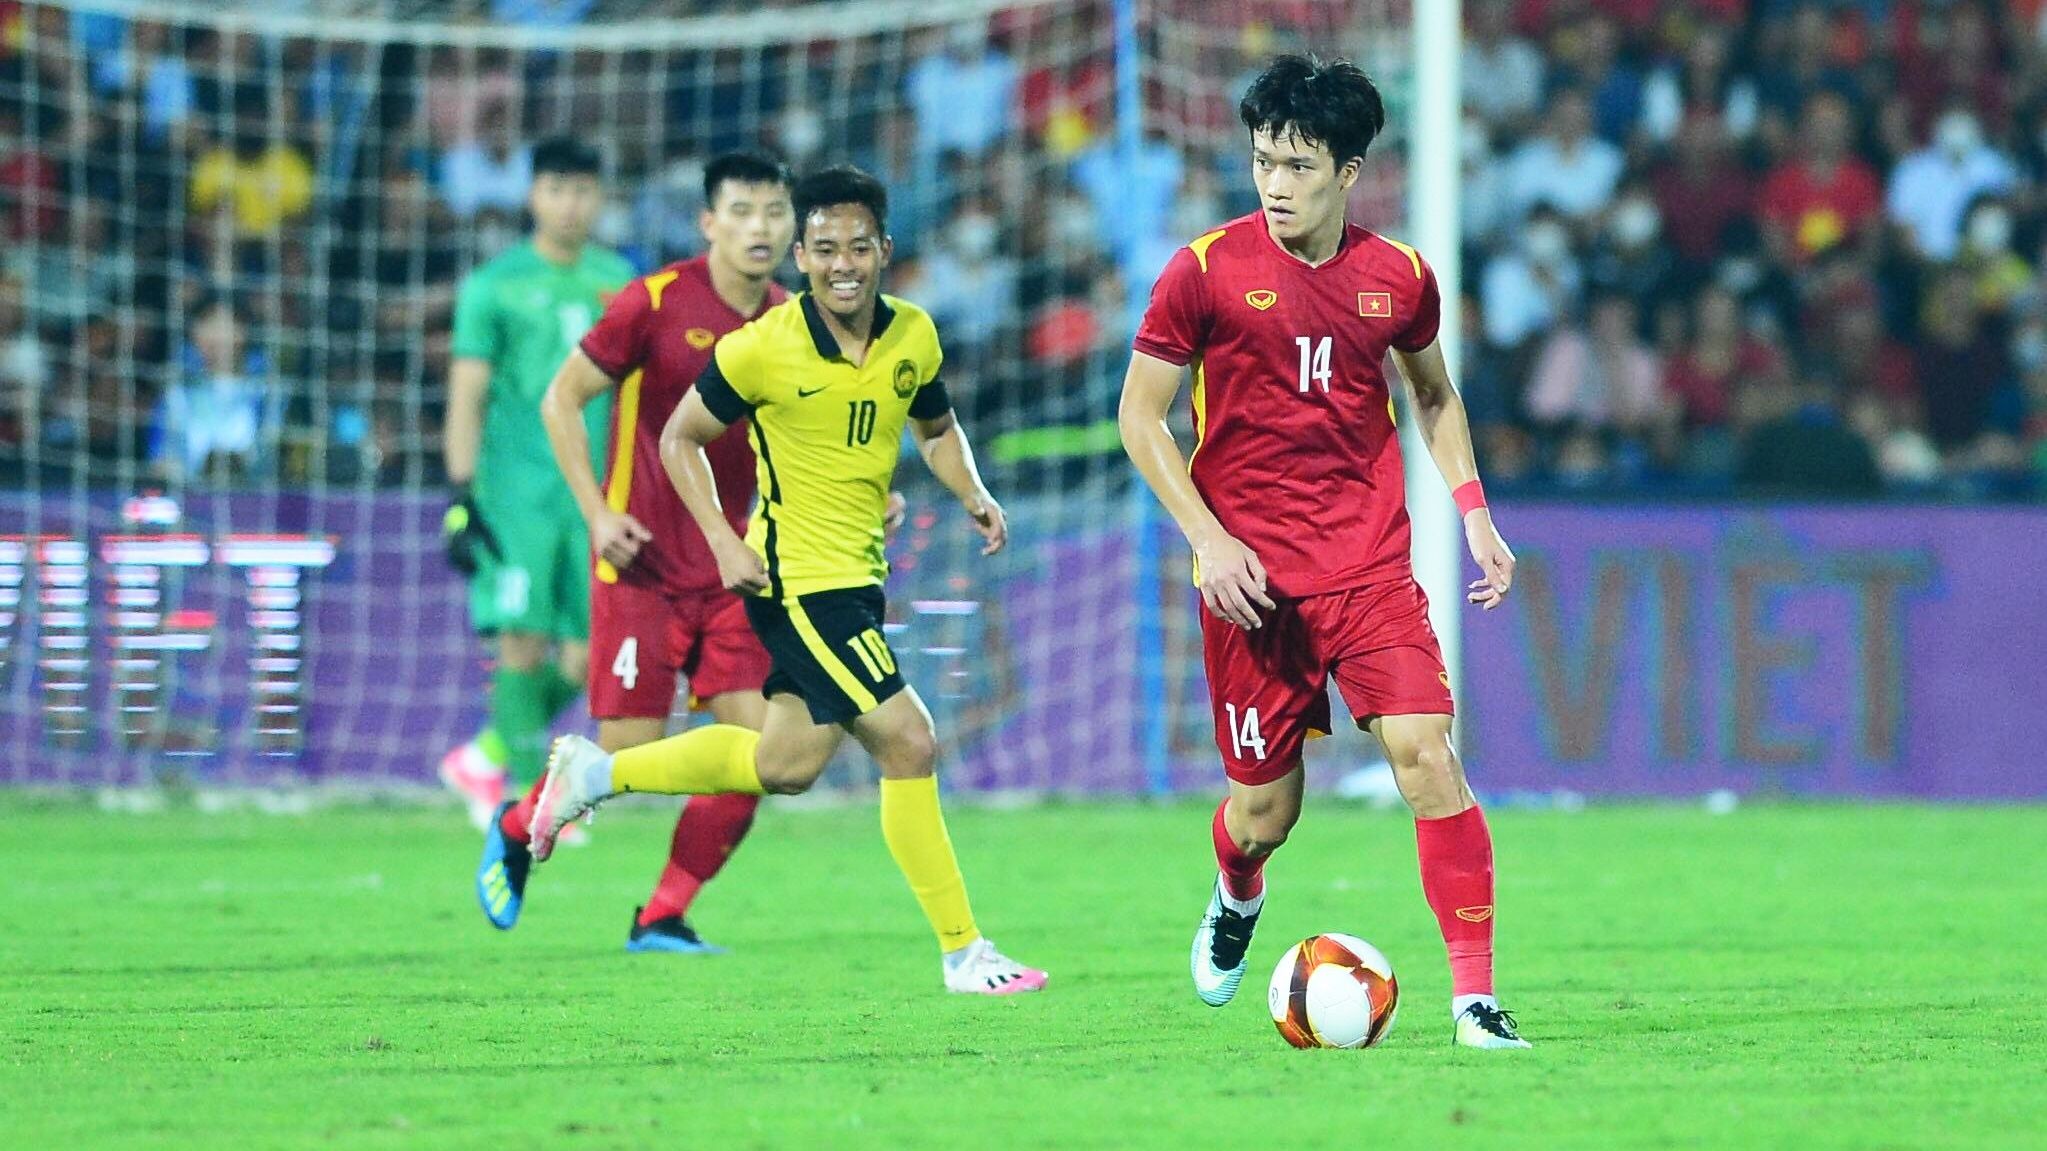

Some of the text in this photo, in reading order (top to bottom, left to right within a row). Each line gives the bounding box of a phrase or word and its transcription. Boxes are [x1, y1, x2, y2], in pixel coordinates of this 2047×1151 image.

[1295, 336, 1333, 393] 14
[847, 400, 877, 448] 10
[611, 636, 639, 690] 4
[846, 628, 896, 683] 10
[1225, 702, 1266, 760] 14
